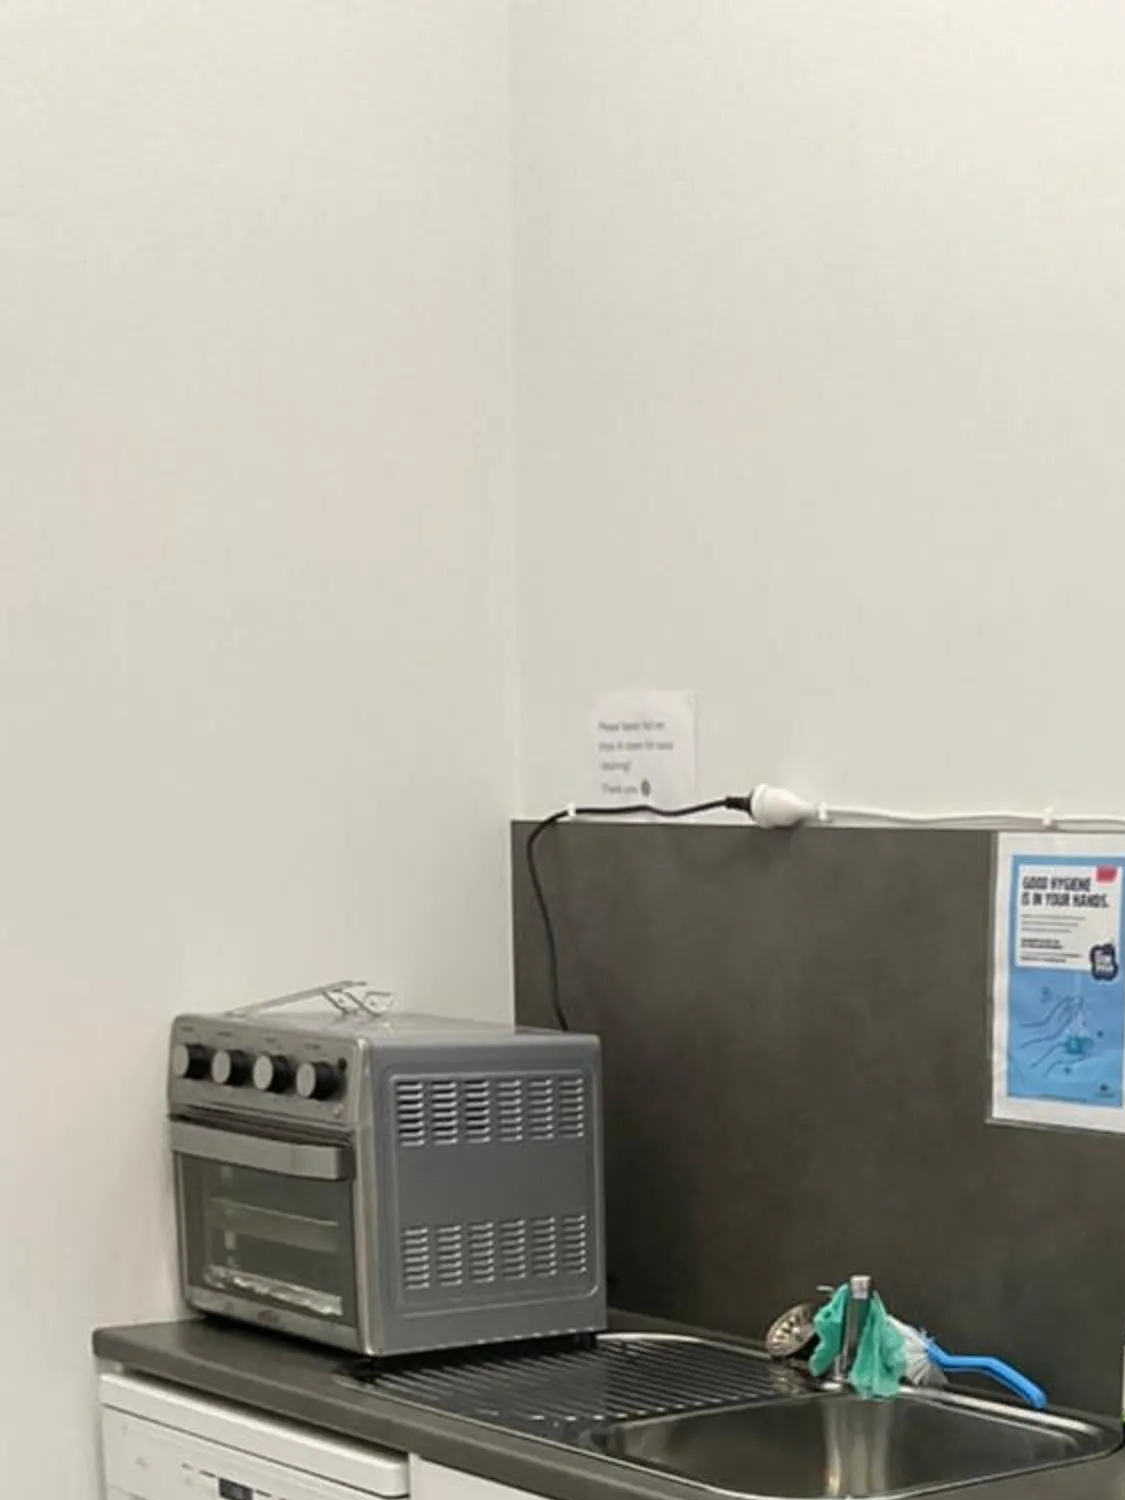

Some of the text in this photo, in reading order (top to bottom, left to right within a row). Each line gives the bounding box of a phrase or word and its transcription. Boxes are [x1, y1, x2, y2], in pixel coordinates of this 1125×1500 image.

[1023, 876, 1091, 892] GOOD HYGIENE
[1021, 892, 1031, 906] IS
[1033, 893, 1042, 906] IN
[1046, 893, 1070, 906] YOUR
